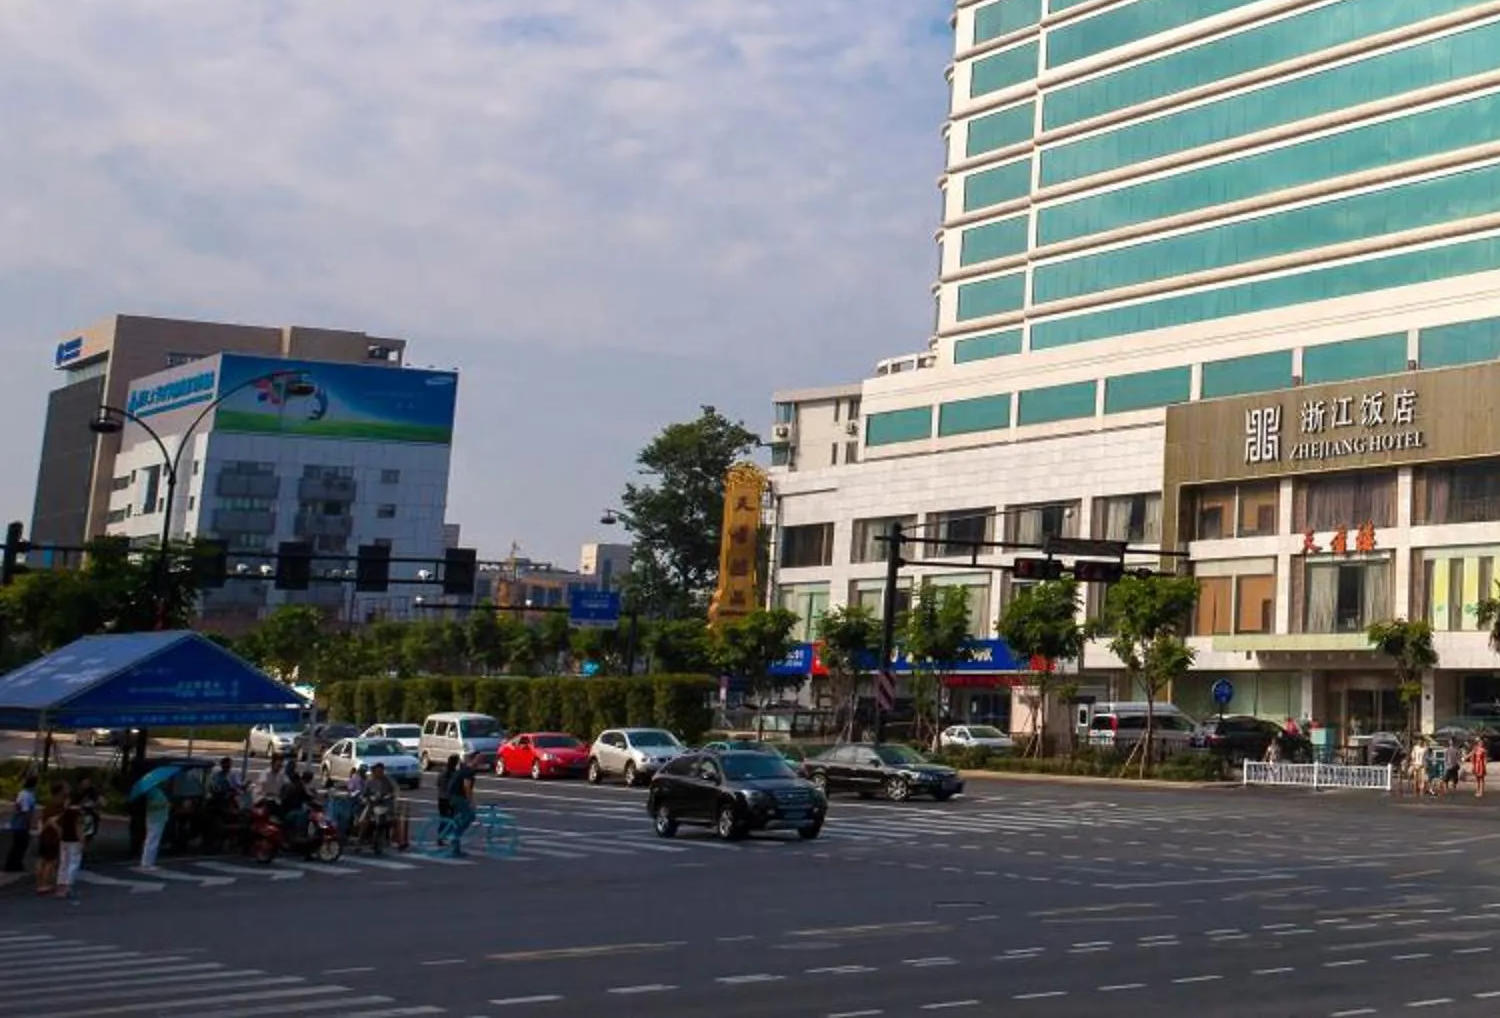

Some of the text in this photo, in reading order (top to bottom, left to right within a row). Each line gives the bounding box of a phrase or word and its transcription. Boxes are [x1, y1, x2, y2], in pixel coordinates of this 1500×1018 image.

[1301, 389, 1418, 433] 浙江饭店
[1289, 431, 1424, 460] ZHEJIANG HOTEL
